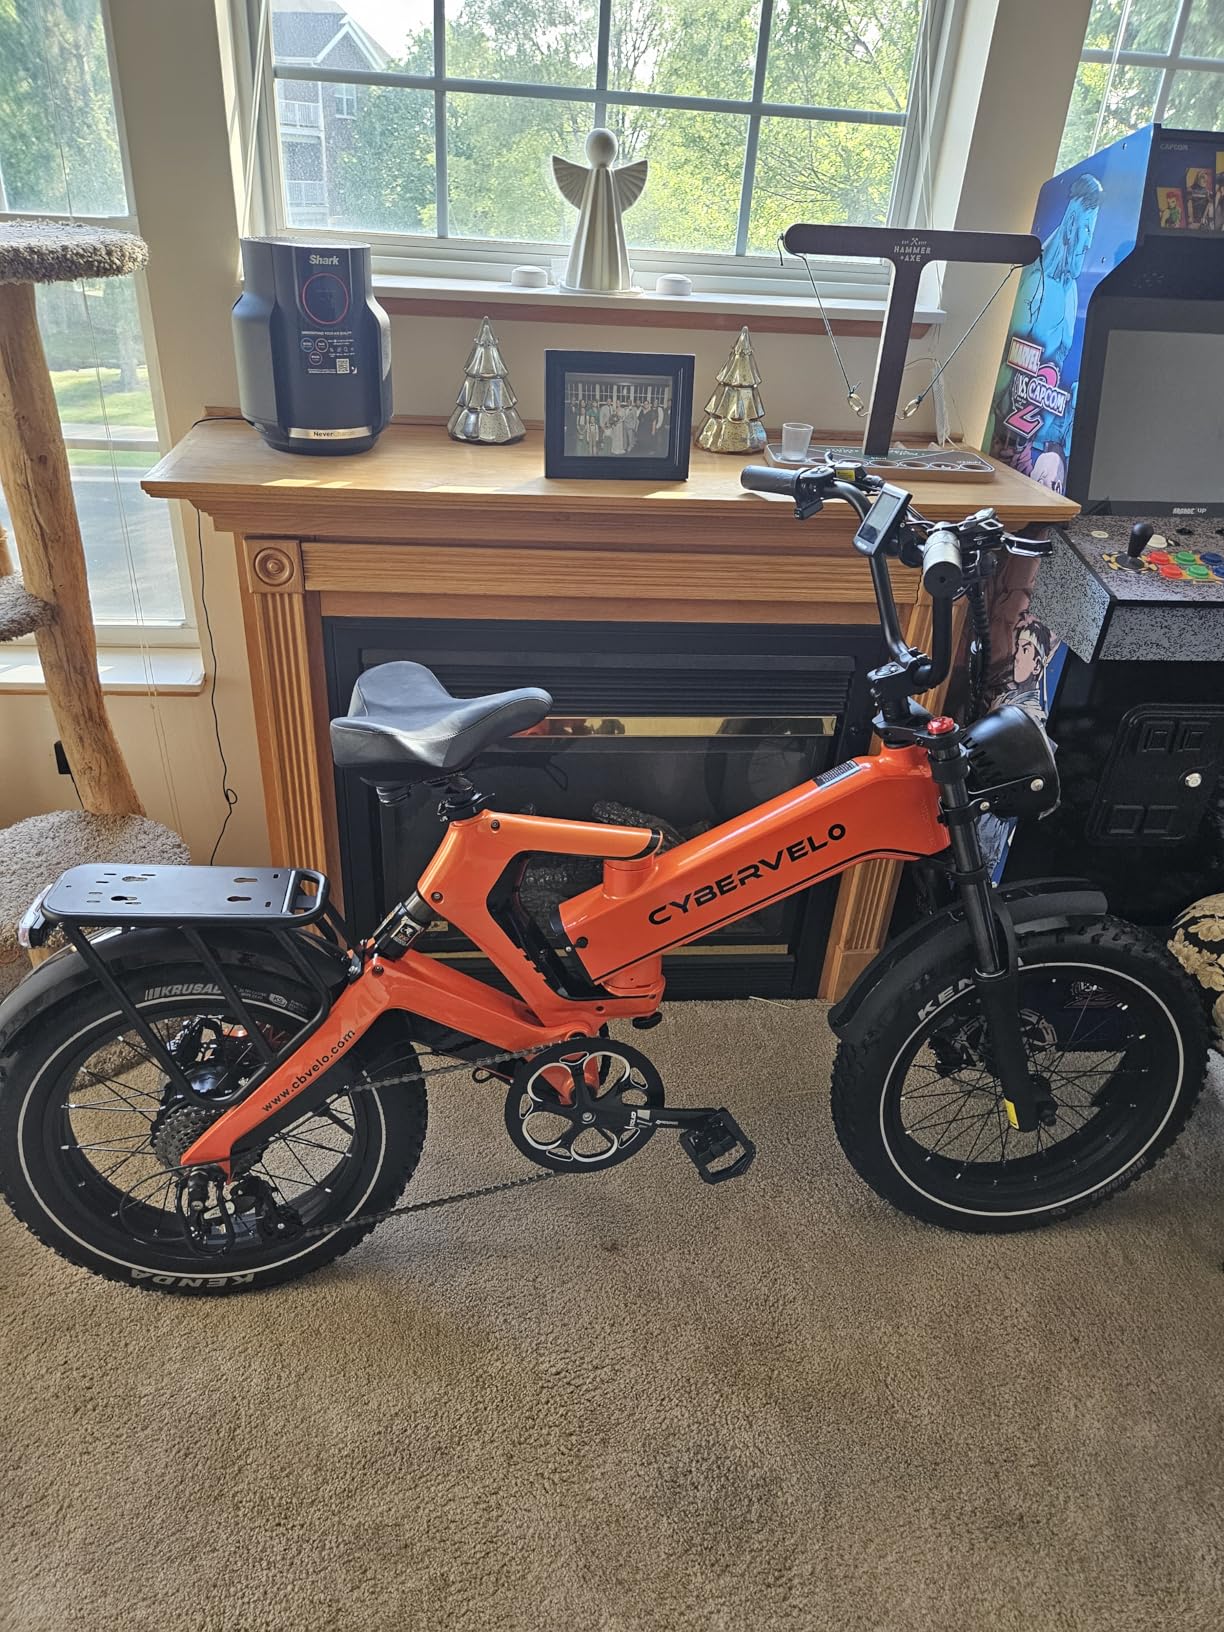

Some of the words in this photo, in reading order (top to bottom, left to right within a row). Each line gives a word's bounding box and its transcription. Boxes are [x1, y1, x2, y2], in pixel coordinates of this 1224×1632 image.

[309, 255, 340, 265] Shark
[893, 245, 931, 254] HAMMER
[1009, 341, 1039, 376] MARVEL
[1028, 381, 1065, 413] CAPCOM
[648, 824, 846, 925] CYBERVELO
[262, 1030, 355, 1112] www.cbvelo.com
[131, 1268, 255, 1288] KENDA
